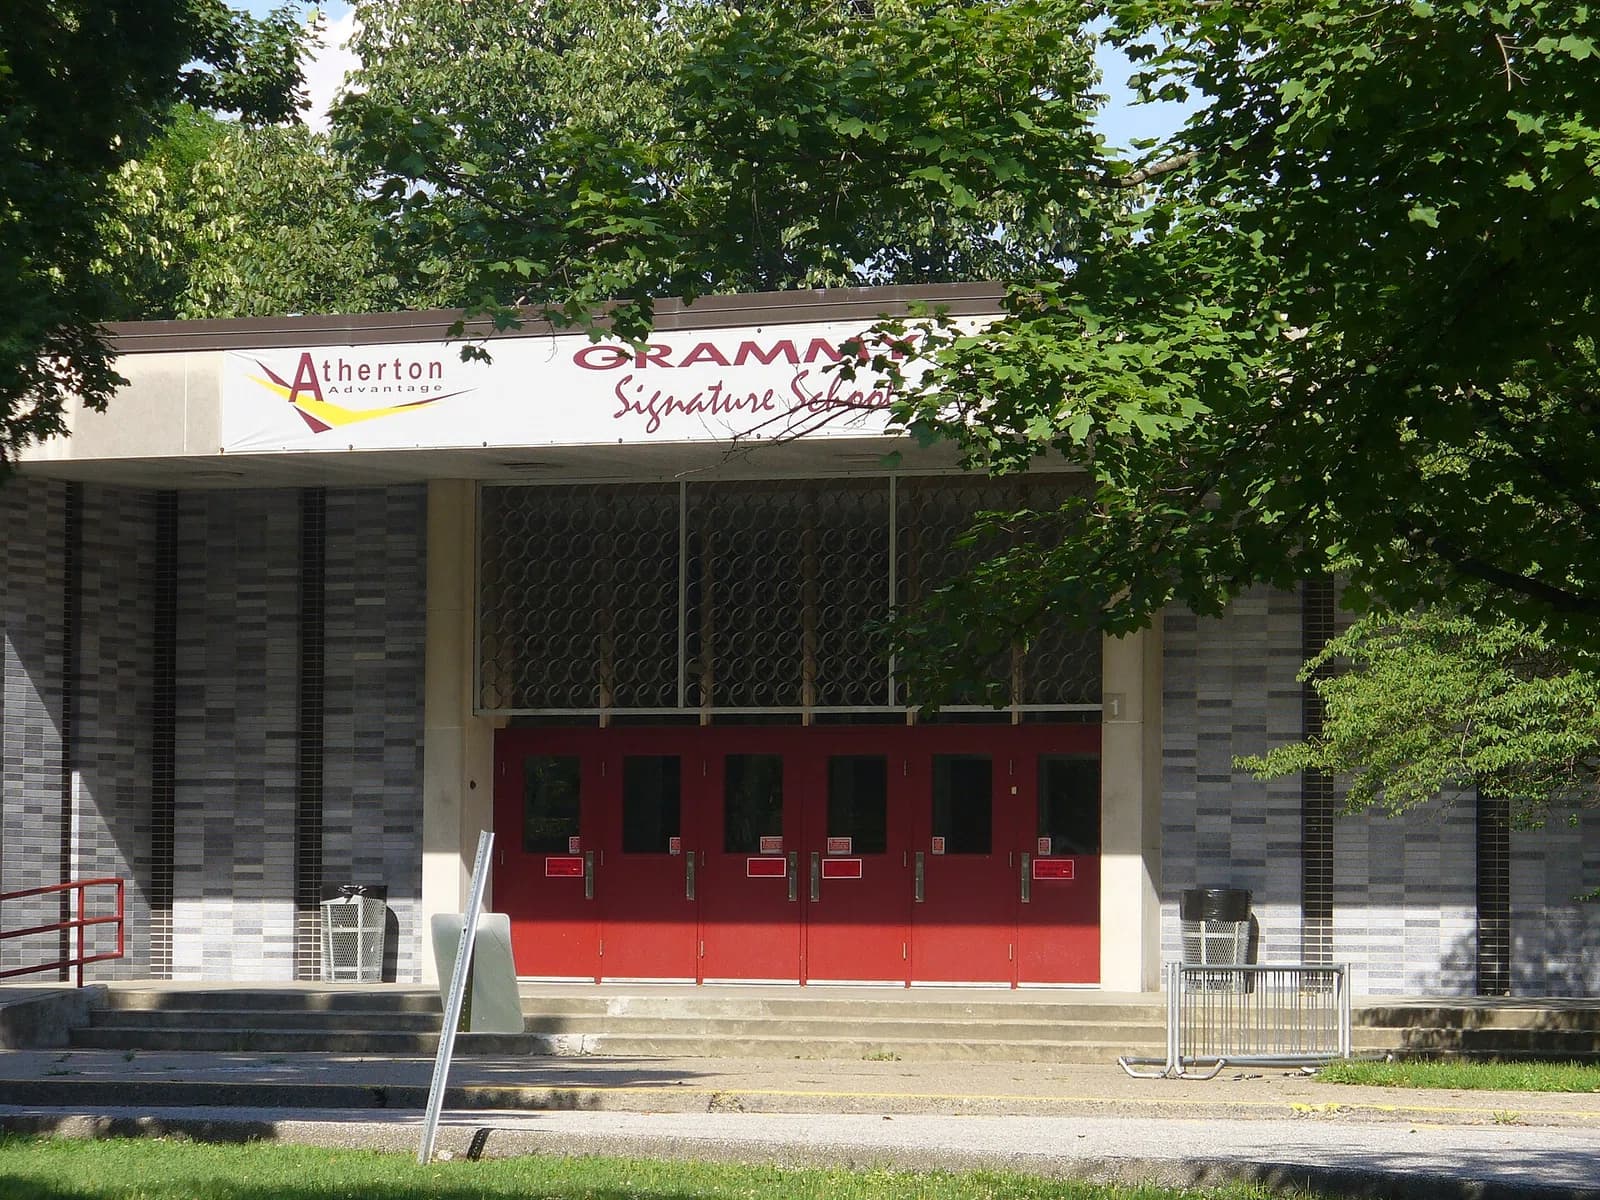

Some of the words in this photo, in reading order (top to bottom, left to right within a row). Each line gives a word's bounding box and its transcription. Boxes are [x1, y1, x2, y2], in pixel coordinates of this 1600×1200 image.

[288, 352, 443, 402] Atherton
[328, 383, 443, 395] Advantage
[613, 374, 775, 434] Signature
